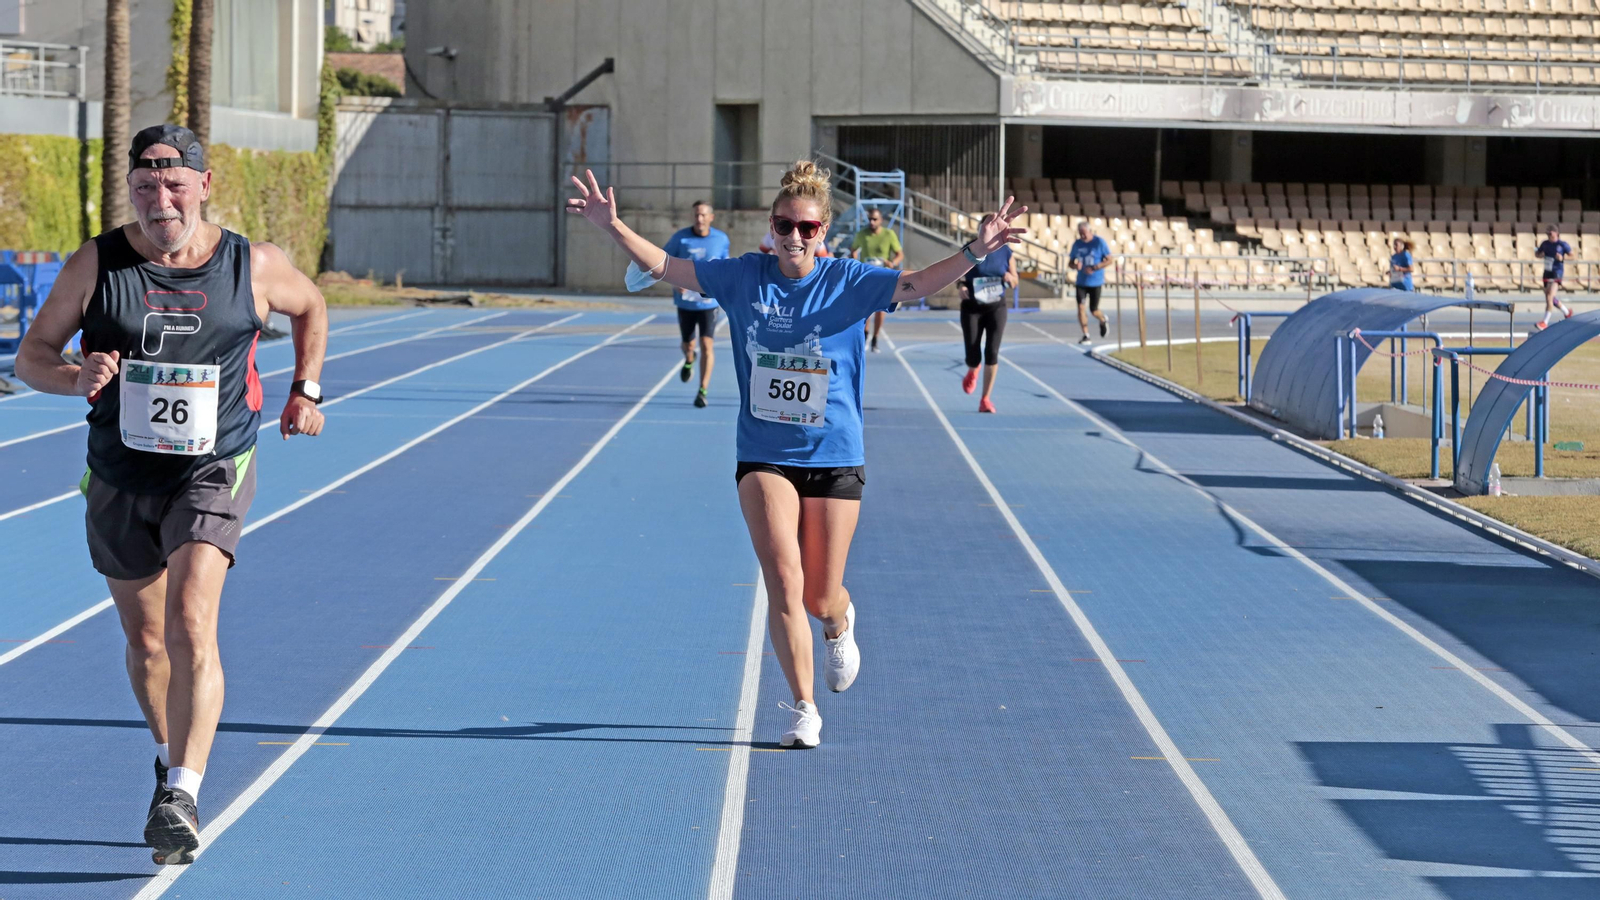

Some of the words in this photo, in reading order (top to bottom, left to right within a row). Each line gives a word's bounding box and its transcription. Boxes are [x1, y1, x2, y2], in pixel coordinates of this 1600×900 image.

[1049, 85, 1150, 115] Cruzcampo
[1288, 92, 1393, 122] Cruzcampo
[770, 315, 793, 324] Carrera
[771, 303, 795, 317] XLI
[768, 321, 793, 329] Popular
[768, 378, 811, 403] 580
[150, 397, 189, 425] 26
